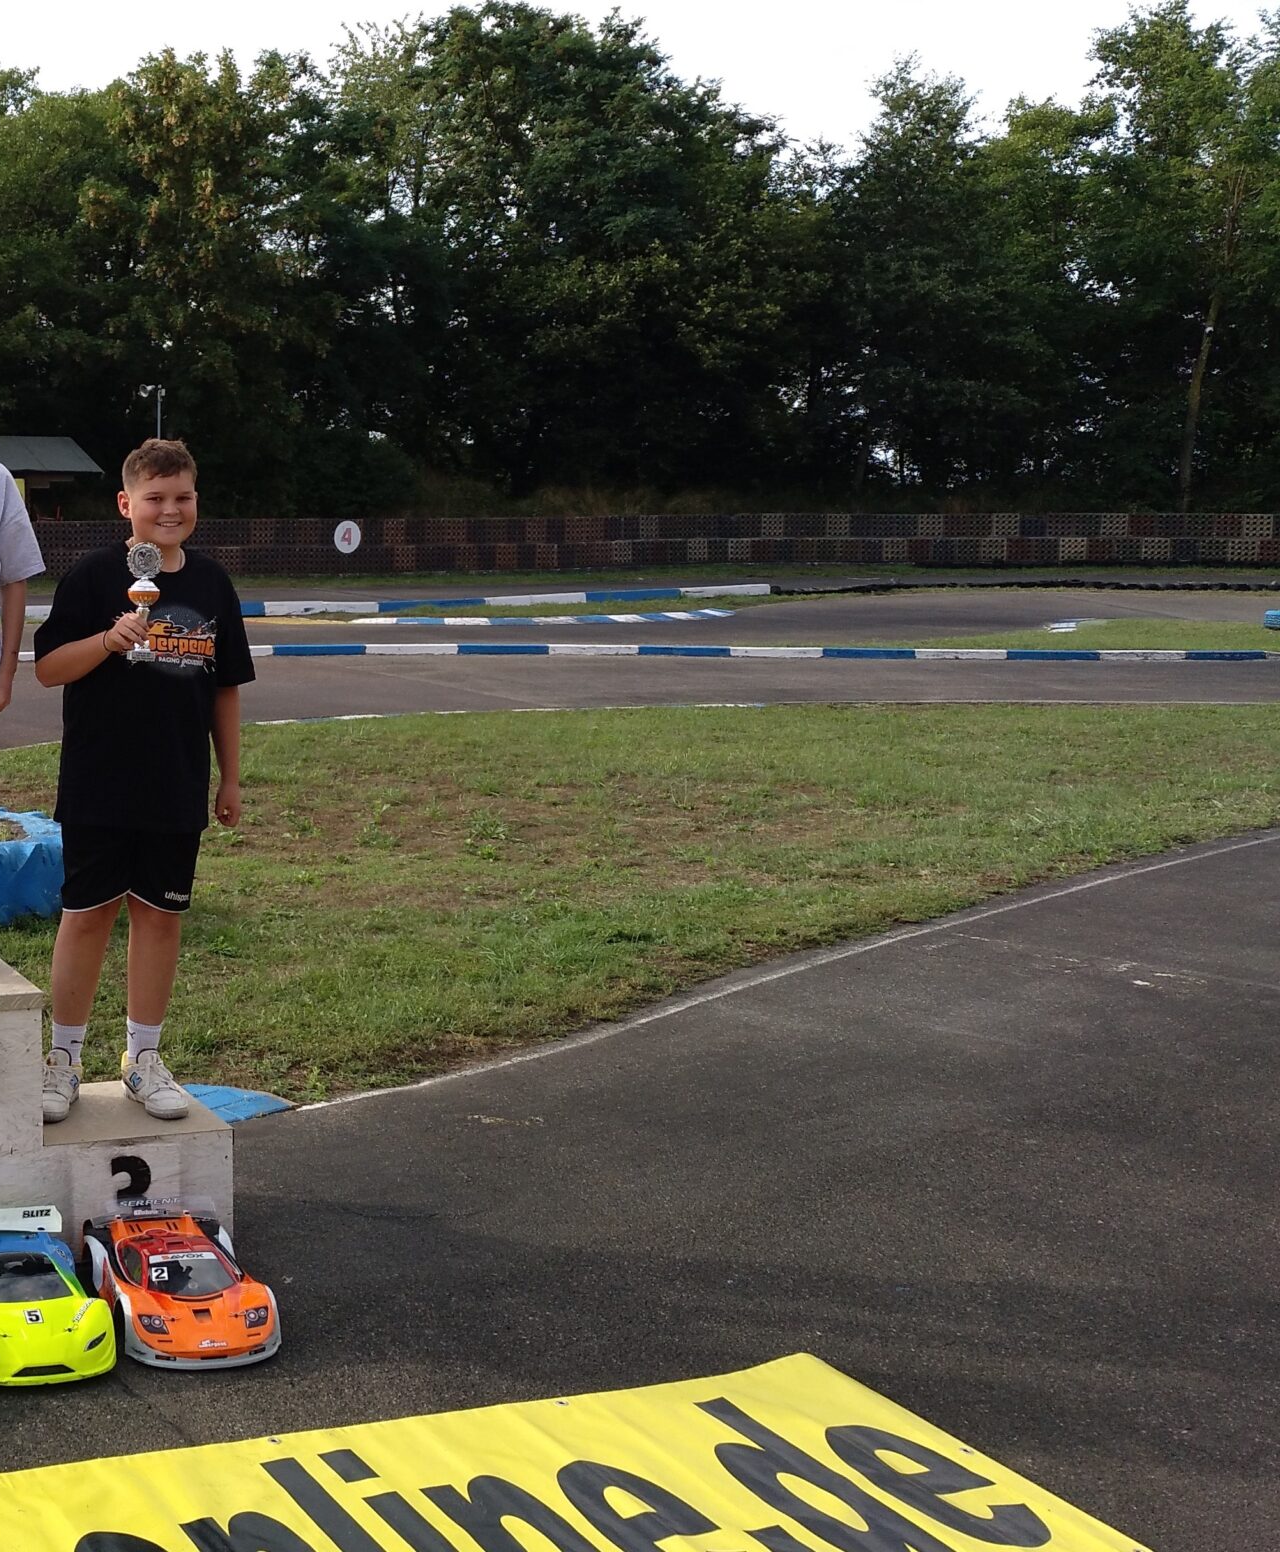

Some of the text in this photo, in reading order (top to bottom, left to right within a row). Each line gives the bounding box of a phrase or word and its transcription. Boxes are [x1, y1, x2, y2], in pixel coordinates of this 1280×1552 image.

[341, 528, 352, 545] 4
[22, 1209, 52, 1218] BLITZ
[154, 1268, 166, 1280] 2
[27, 1311, 40, 1322] 5
